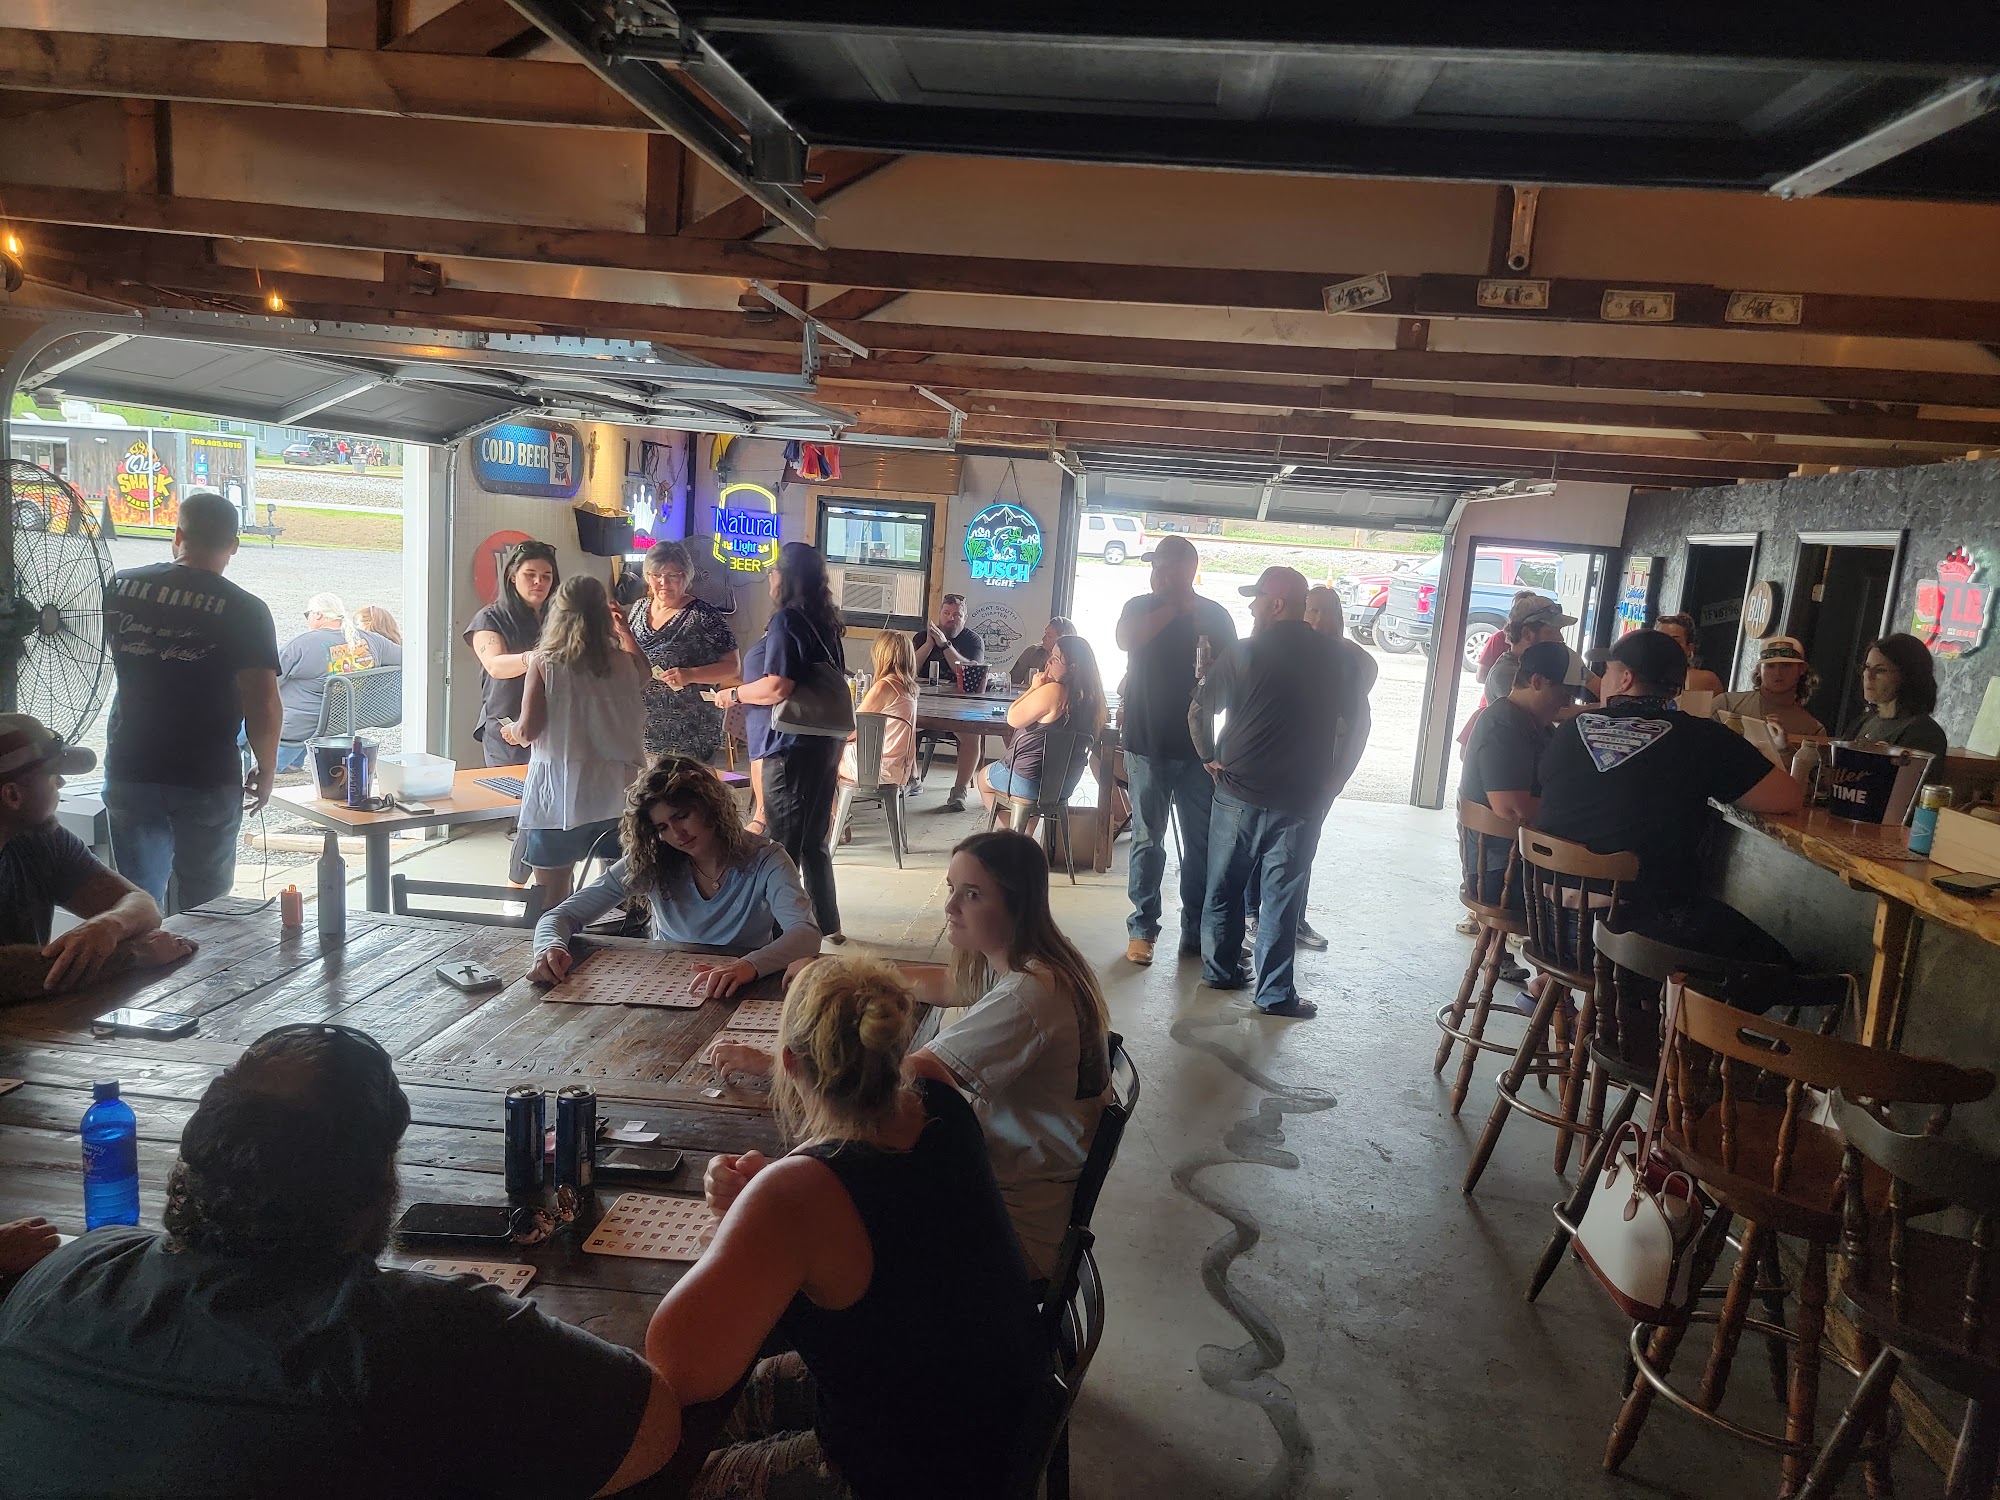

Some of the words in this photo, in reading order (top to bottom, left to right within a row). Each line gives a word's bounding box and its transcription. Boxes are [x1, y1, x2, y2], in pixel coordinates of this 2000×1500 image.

[482, 438, 514, 465] COLD
[517, 442, 549, 468] BEER
[715, 508, 779, 538] Natural
[733, 539, 758, 556] Light
[730, 557, 762, 572] BEER
[971, 560, 1031, 583] BUSCH
[157, 586, 226, 614] RANGER
[1747, 589, 1768, 629] BAR
[972, 605, 994, 618] GREAT
[995, 605, 1018, 621] SOUTH
[981, 611, 1008, 620] CHAPTER
[1618, 600, 1647, 623] ULTRA
[1600, 743, 1623, 751] GEAR
[1832, 784, 1867, 804] TIME
